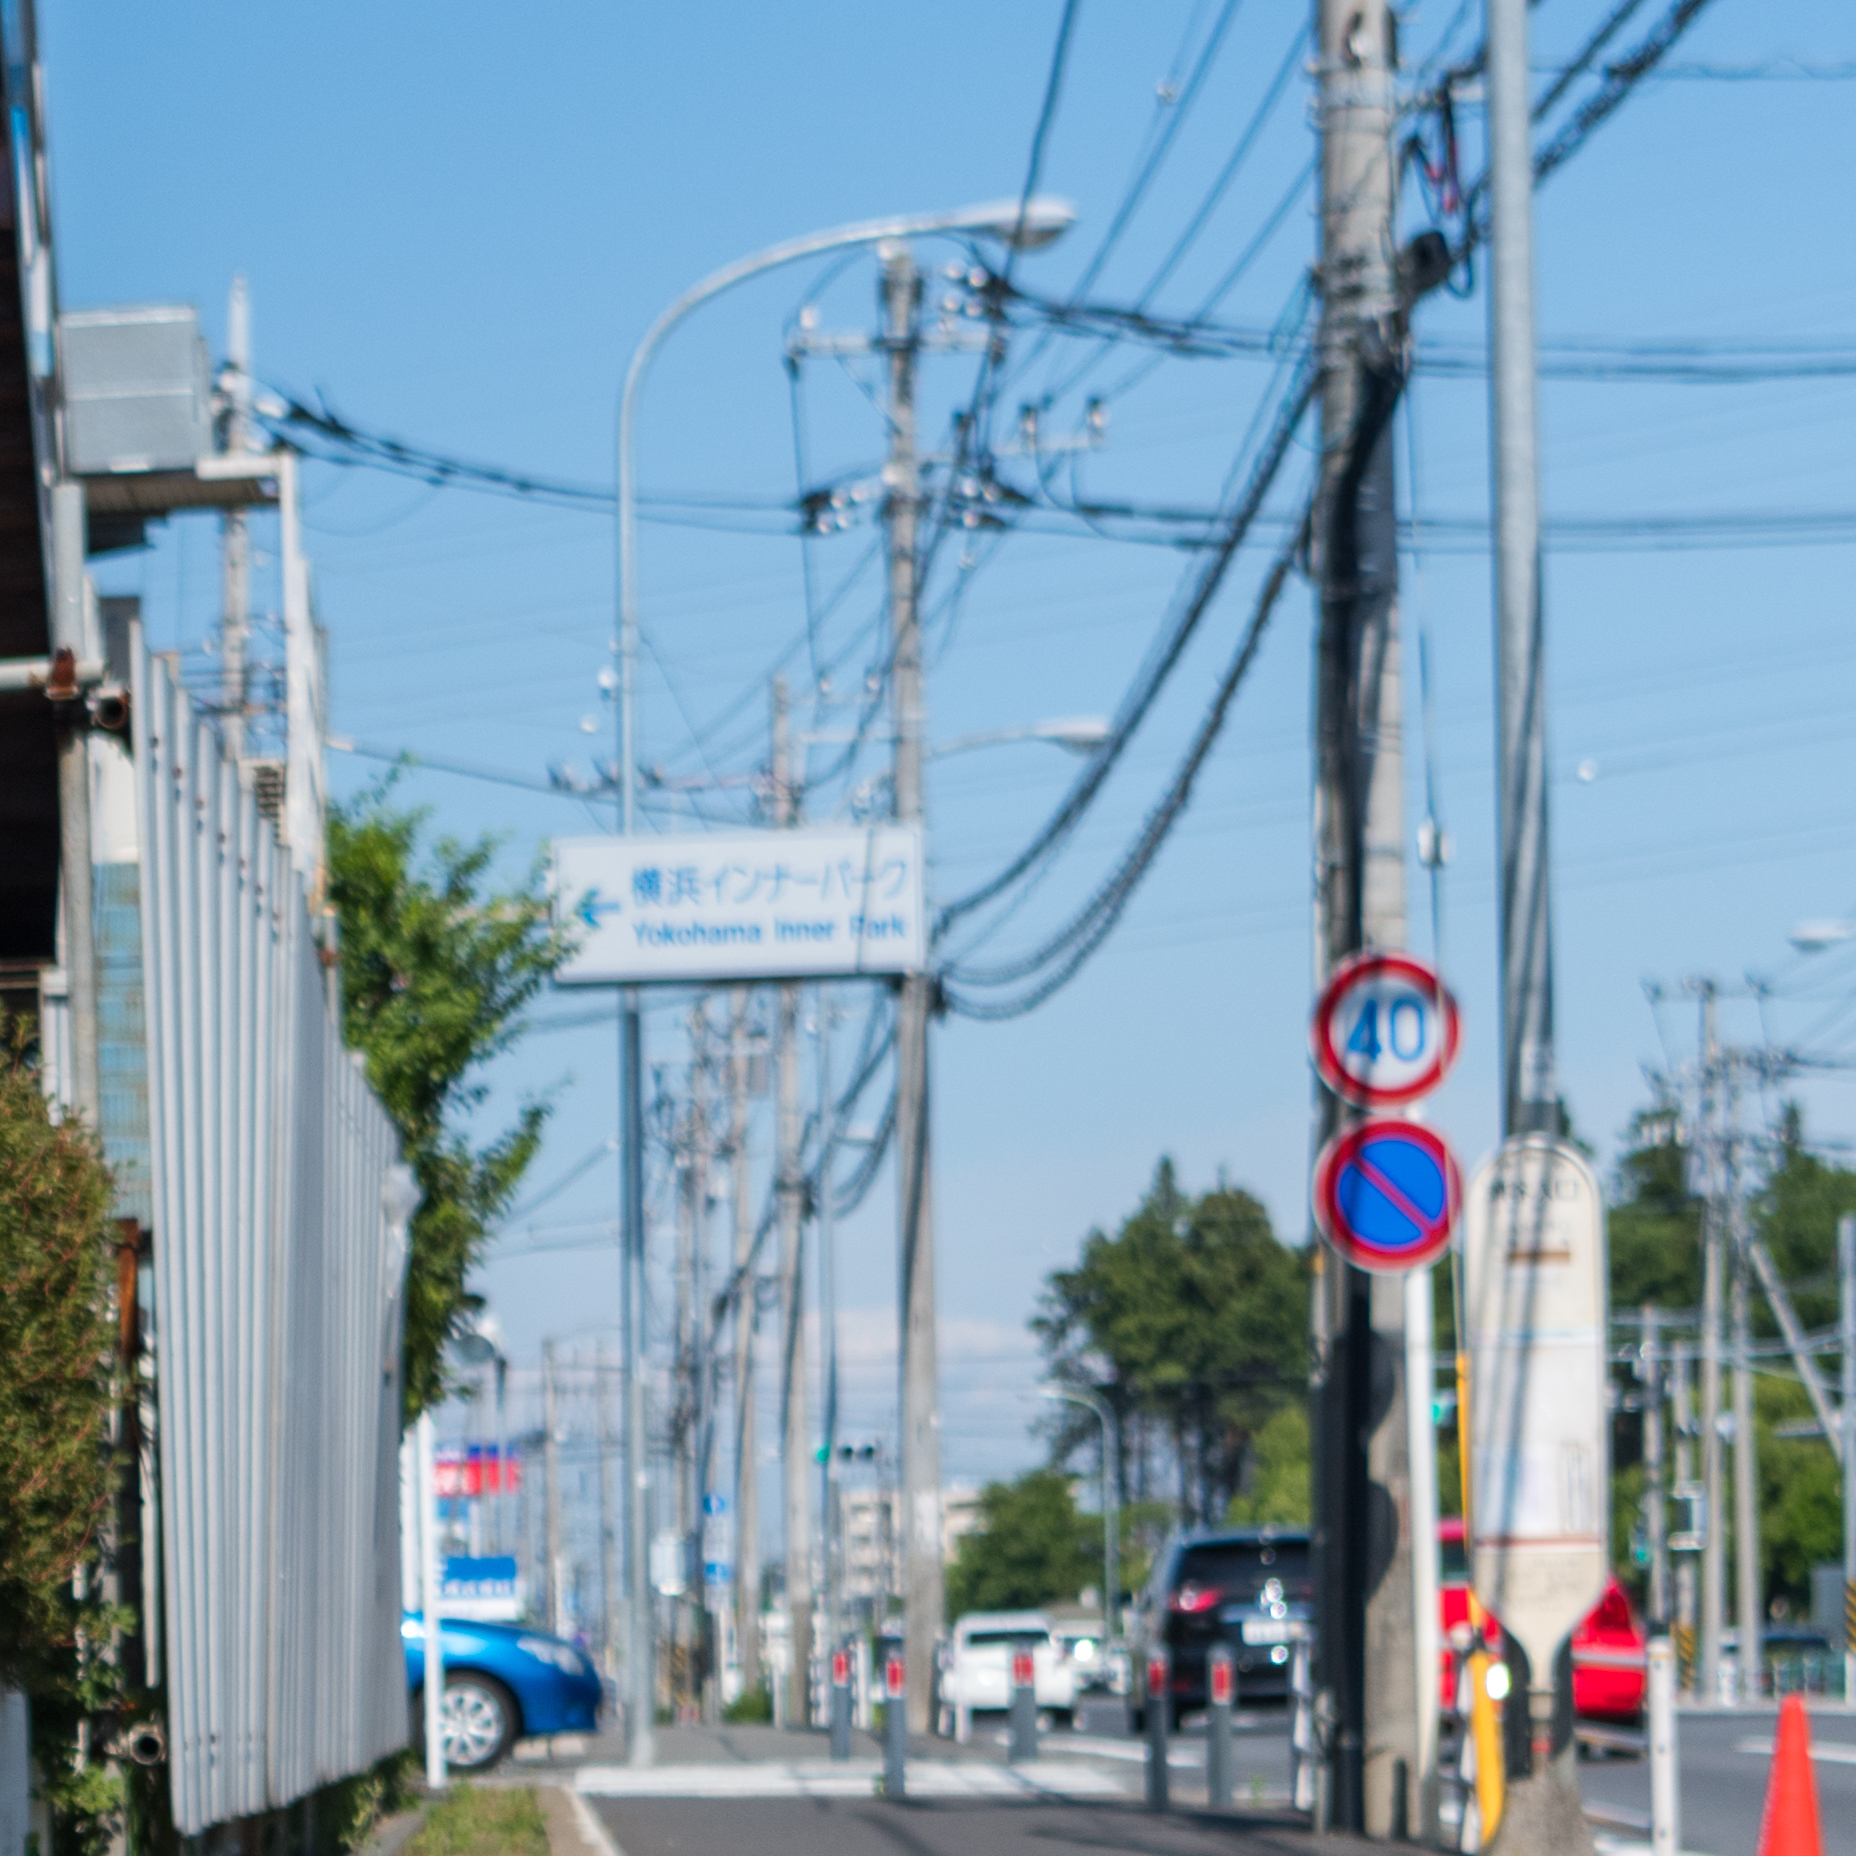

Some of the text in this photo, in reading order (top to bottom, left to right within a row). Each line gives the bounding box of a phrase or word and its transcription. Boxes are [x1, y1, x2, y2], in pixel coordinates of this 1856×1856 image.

[630, 860, 907, 907] 横浜インナーパーク
[633, 911, 906, 947] Yokohama Inner Park
[1347, 997, 1426, 1063] 40
